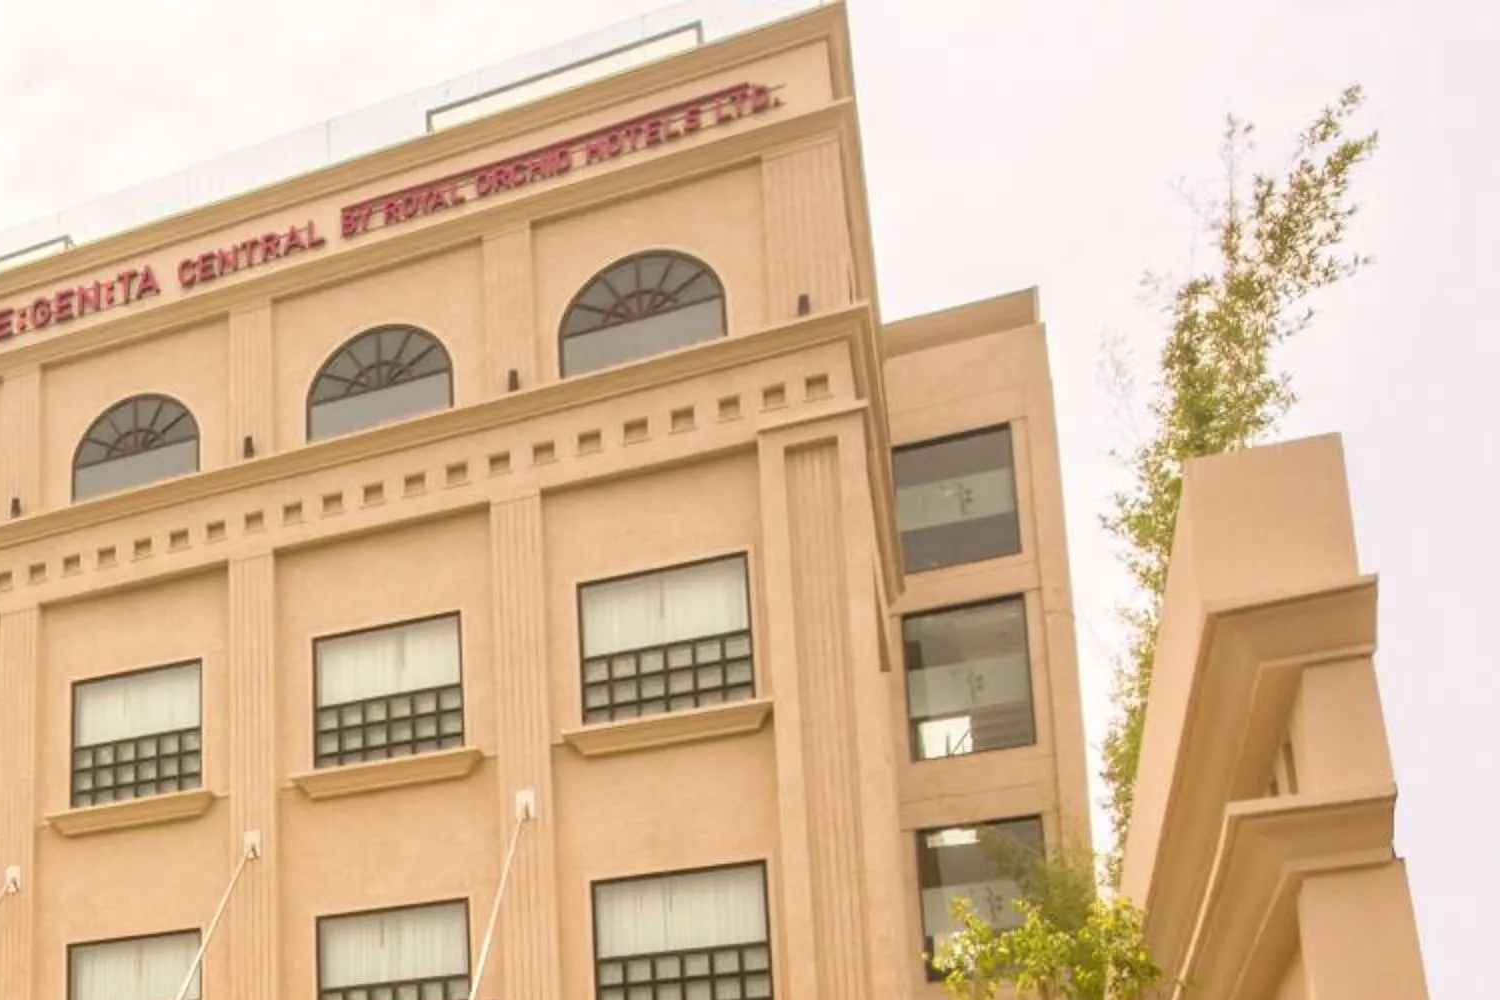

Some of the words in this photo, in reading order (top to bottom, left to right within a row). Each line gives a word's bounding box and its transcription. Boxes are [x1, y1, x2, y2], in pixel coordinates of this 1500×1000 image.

[178, 220, 327, 288] CENTRAL
[340, 202, 373, 239] BY
[380, 186, 466, 227] ROYAL
[475, 147, 573, 200] ORCHID
[586, 106, 701, 167] HOTELS
